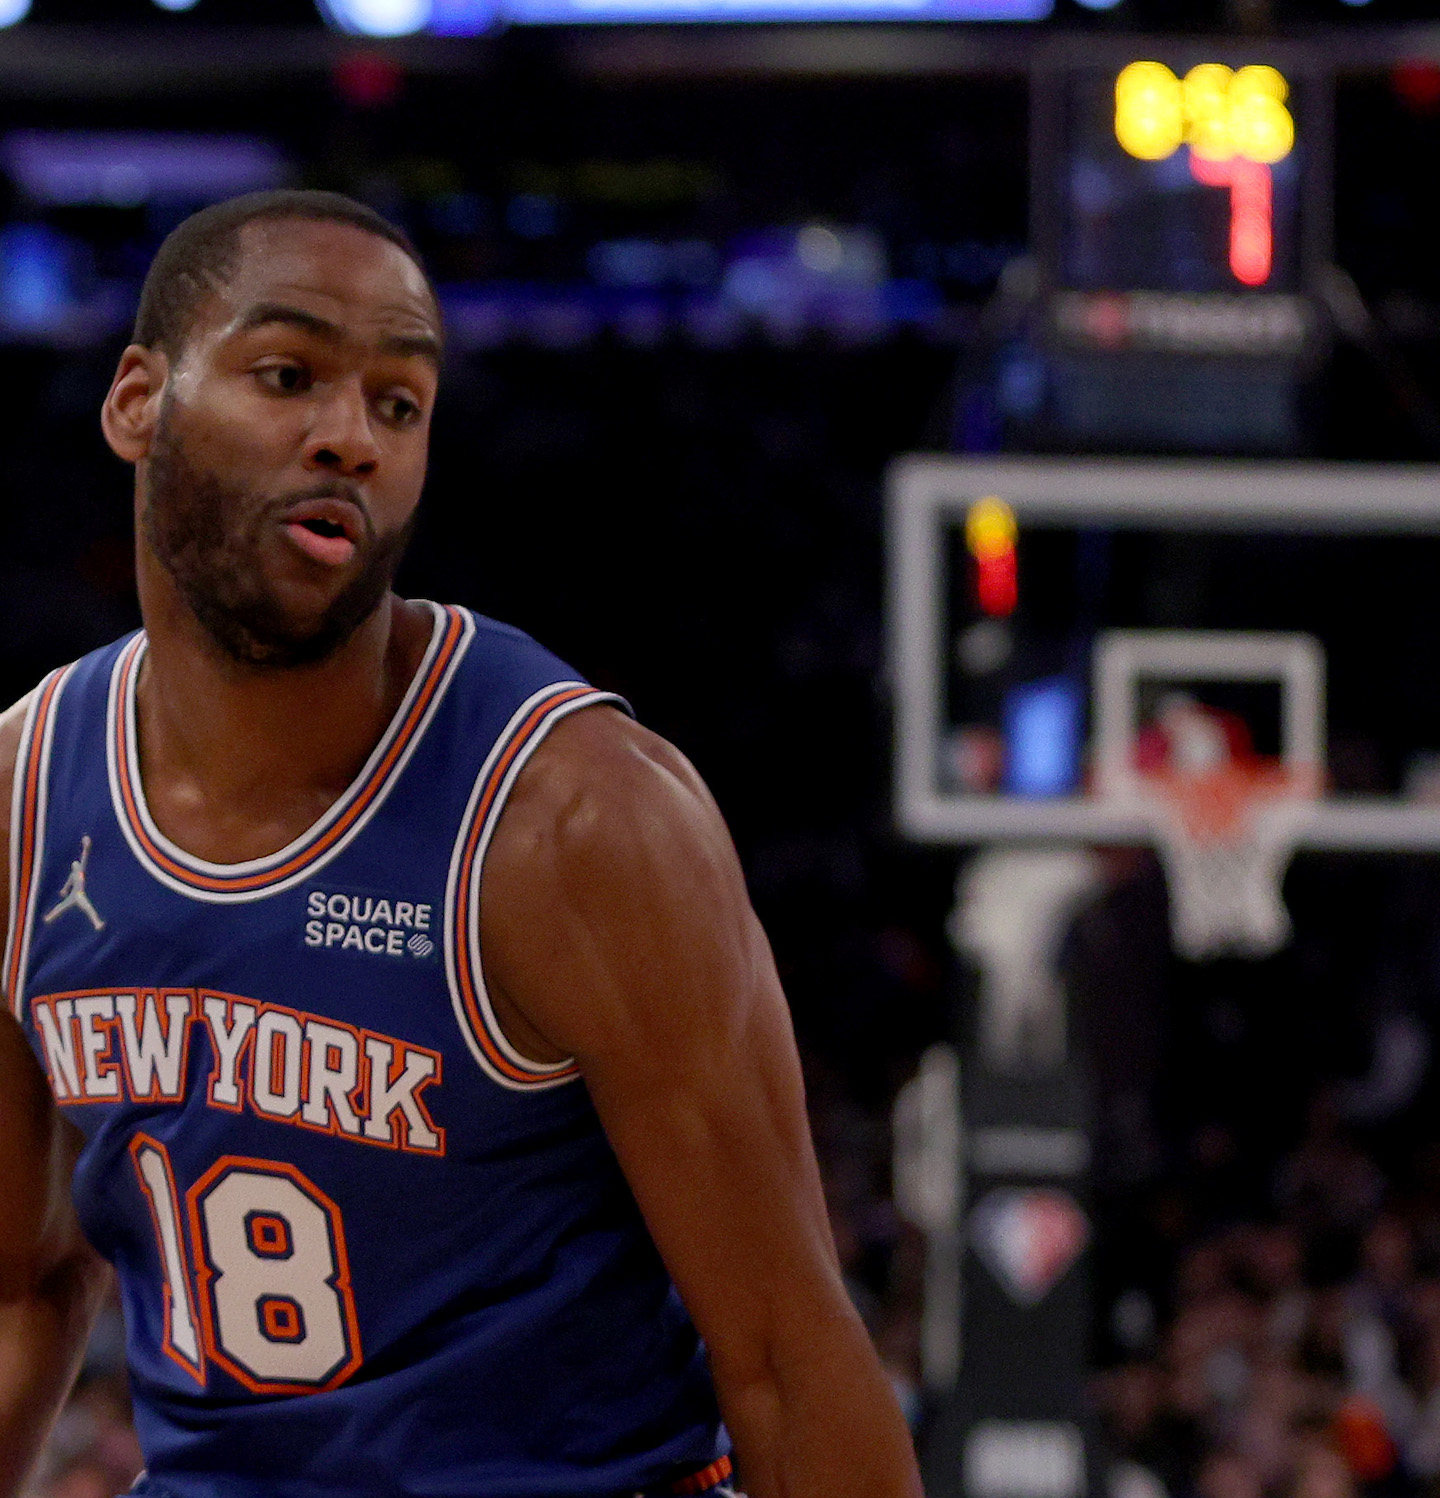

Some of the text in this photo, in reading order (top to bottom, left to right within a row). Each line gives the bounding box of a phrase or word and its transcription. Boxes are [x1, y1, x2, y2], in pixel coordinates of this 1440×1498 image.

[304, 920, 405, 957] SPACE
[306, 891, 432, 930] SQUARE
[31, 987, 445, 1155] NEW YORK
[129, 1131, 363, 1394] 18
